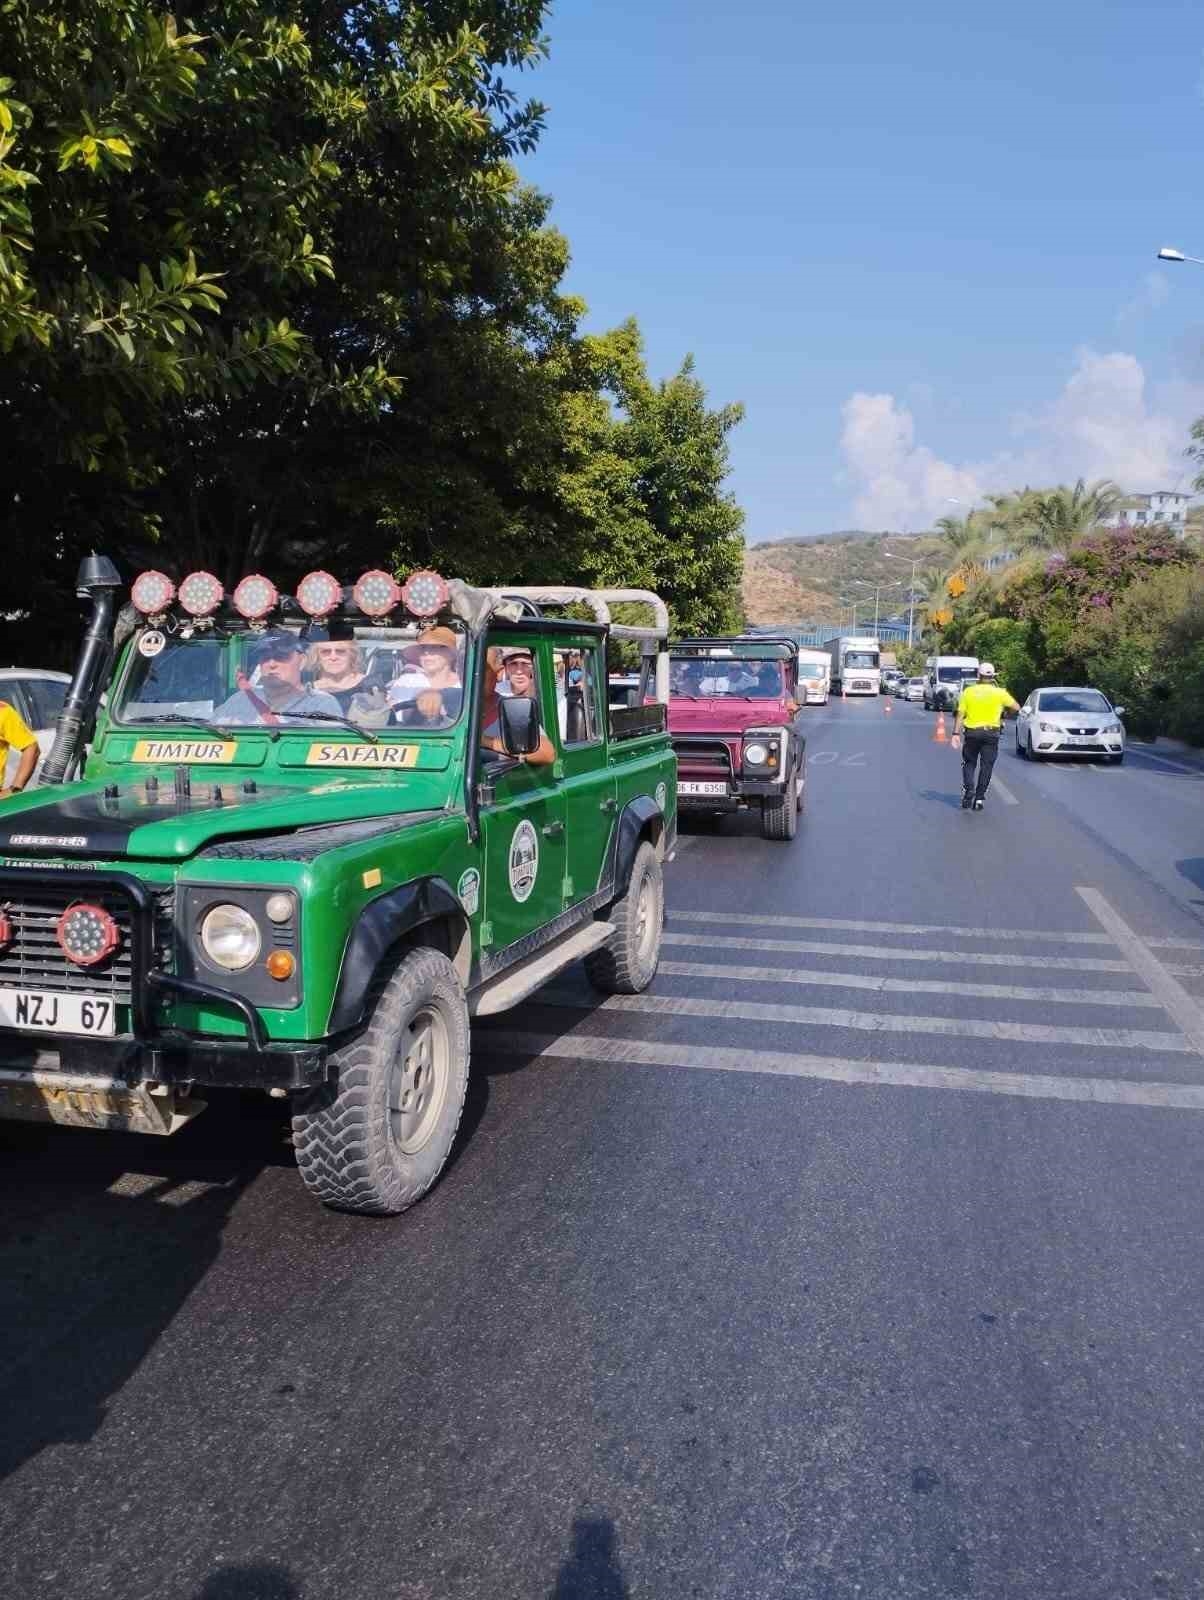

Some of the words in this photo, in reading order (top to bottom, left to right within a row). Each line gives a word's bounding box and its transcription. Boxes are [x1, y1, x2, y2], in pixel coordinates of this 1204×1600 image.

[145, 742, 224, 760] TIMTUR
[318, 745, 409, 763] SAFARI
[15, 994, 58, 1027] NZJ
[81, 1000, 110, 1031] 67
